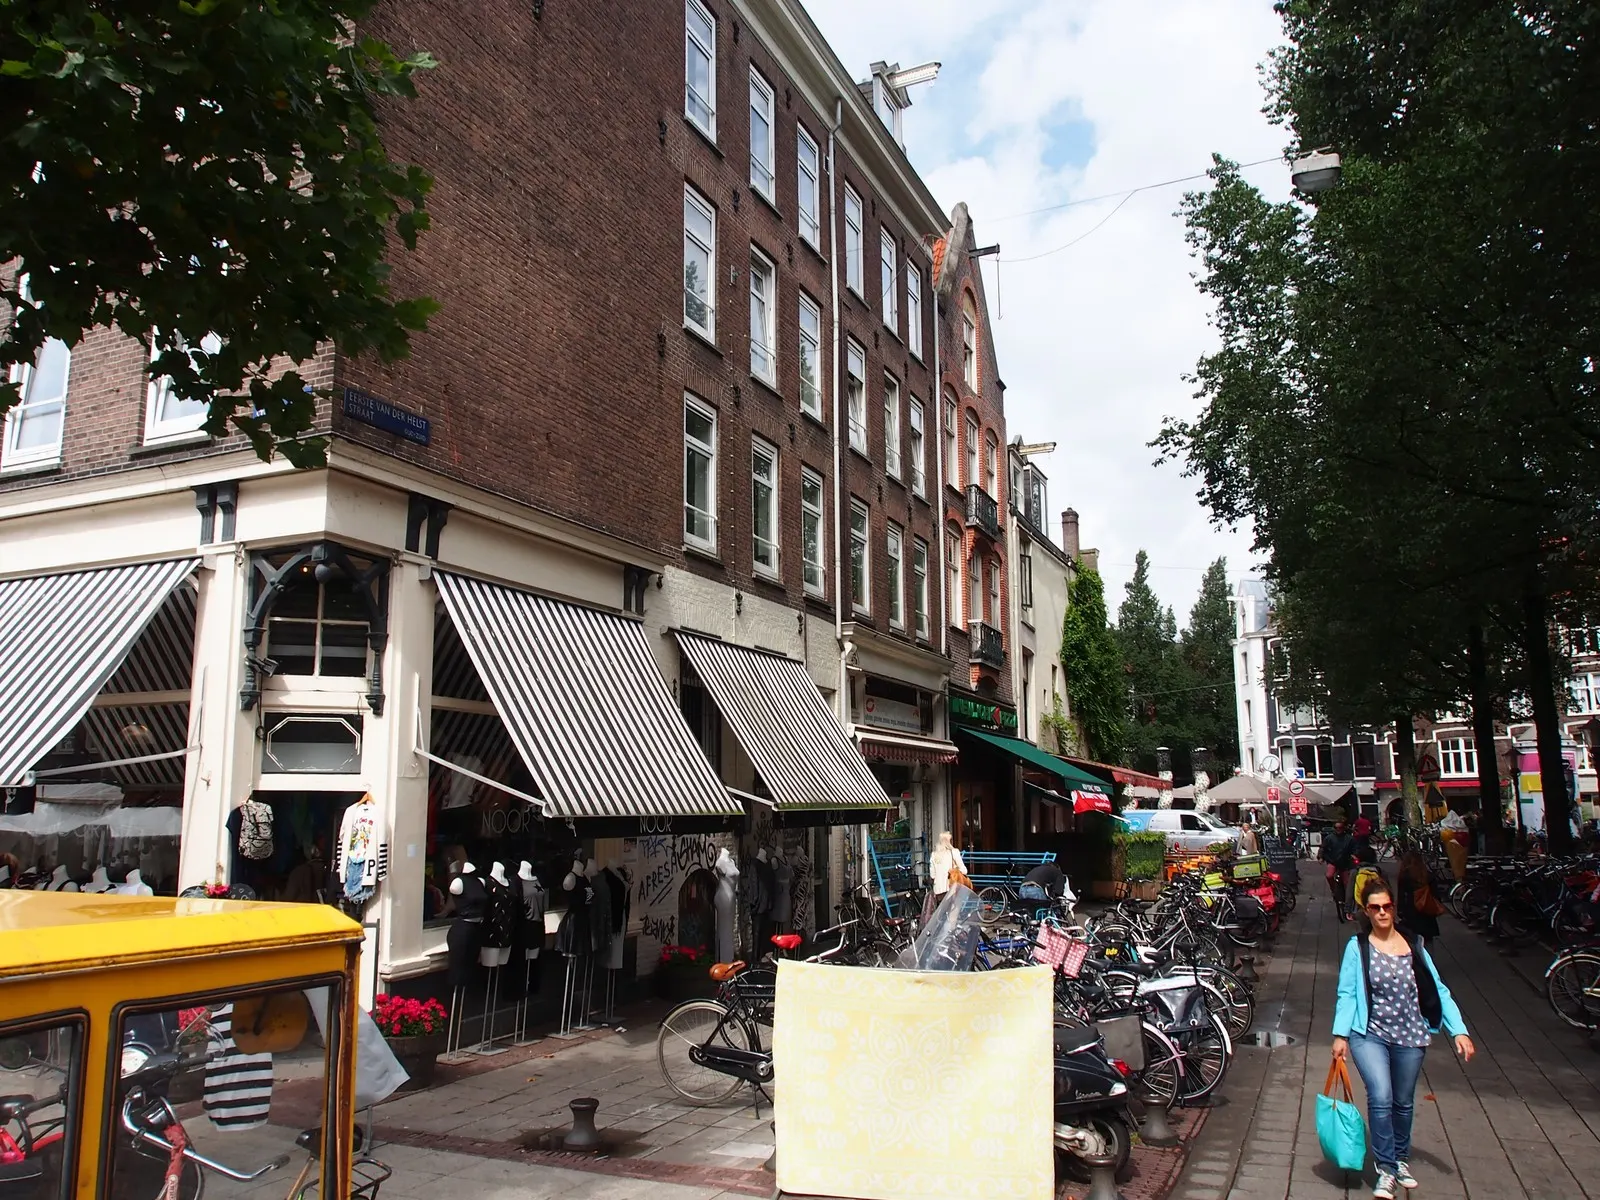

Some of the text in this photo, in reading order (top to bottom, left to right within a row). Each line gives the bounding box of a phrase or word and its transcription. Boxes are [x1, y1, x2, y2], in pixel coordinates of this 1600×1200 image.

[348, 403, 375, 421] STRAAT
[349, 391, 427, 430] EERSTE VAN DER HELST
[481, 809, 531, 834] NOOR
[639, 815, 673, 834] NOOR
[366, 859, 376, 877] P
